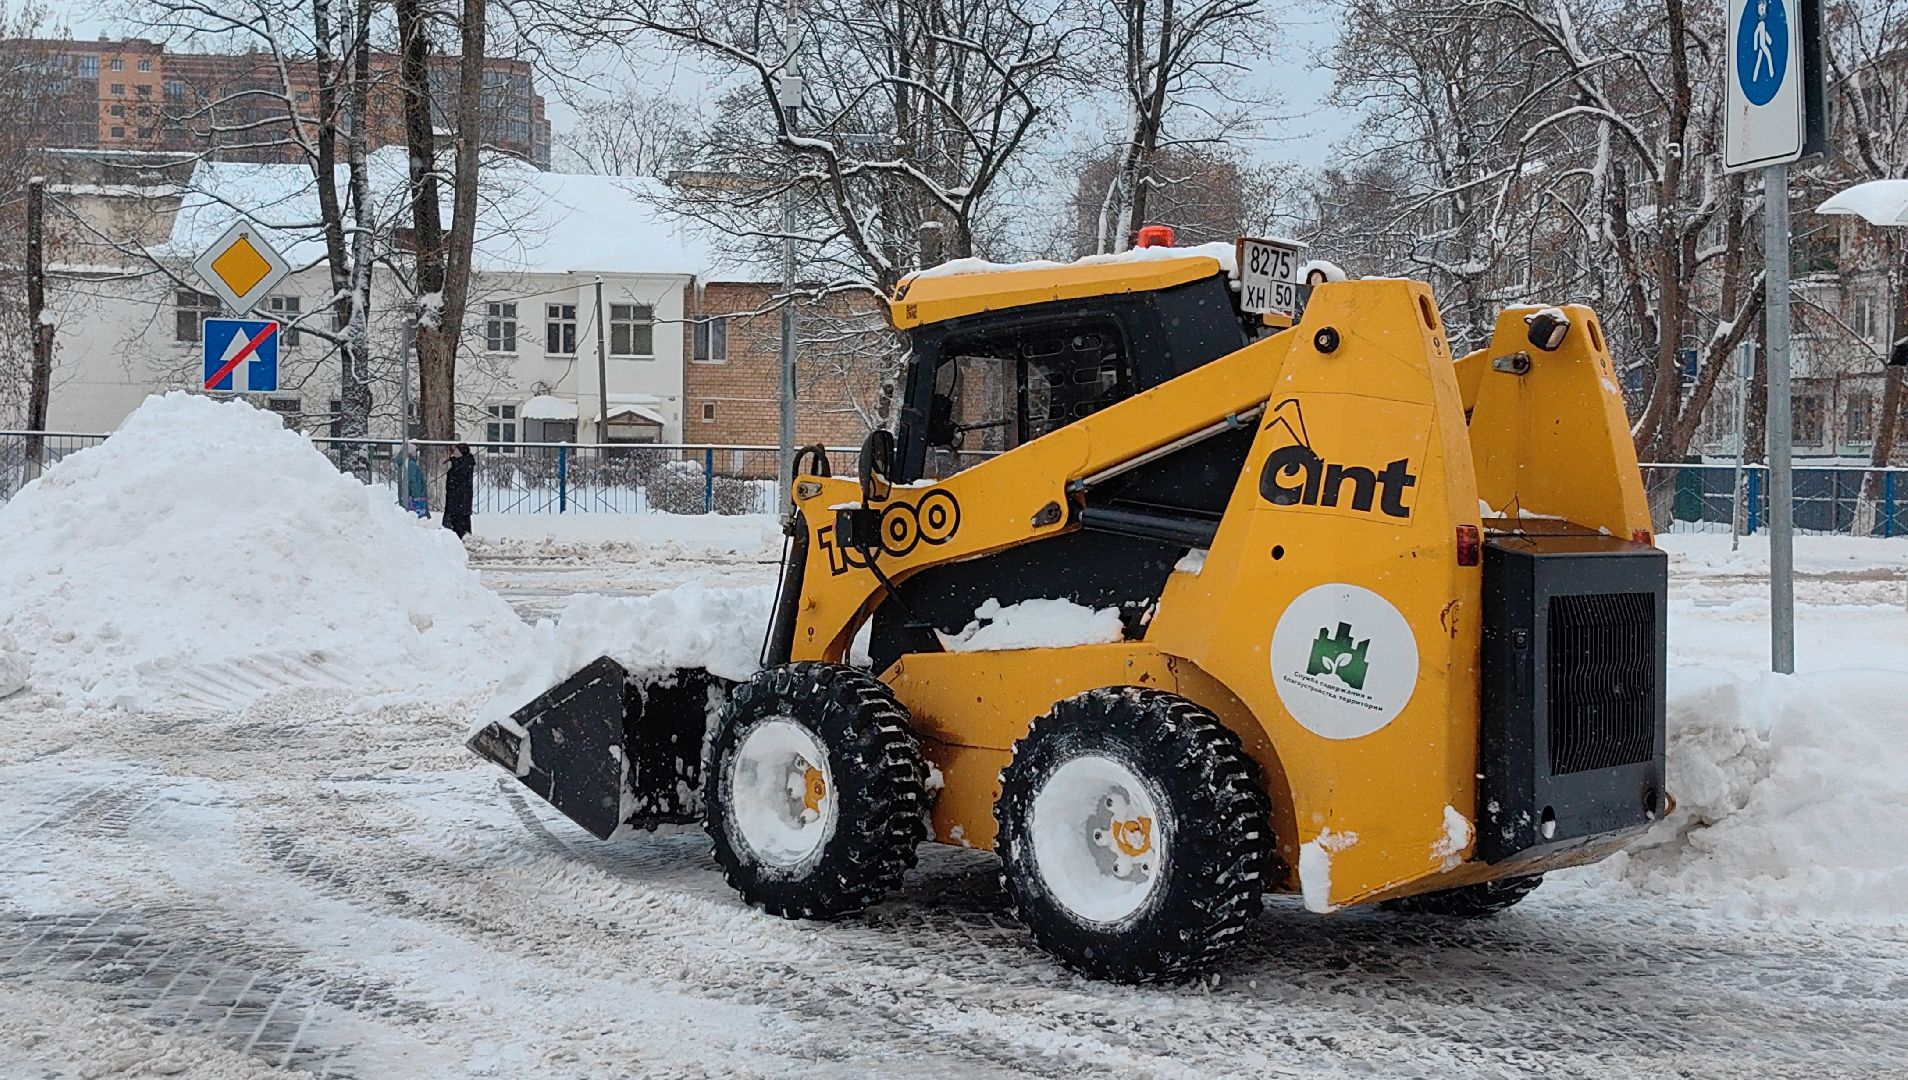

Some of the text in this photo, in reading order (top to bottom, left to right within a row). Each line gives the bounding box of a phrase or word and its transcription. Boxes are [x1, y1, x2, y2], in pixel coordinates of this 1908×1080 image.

[1251, 246, 1290, 279] 8275
[1275, 284, 1292, 306] 50
[1259, 445, 1416, 518] ant
[1294, 671, 1319, 685] Служба
[1320, 681, 1365, 699] содержания
